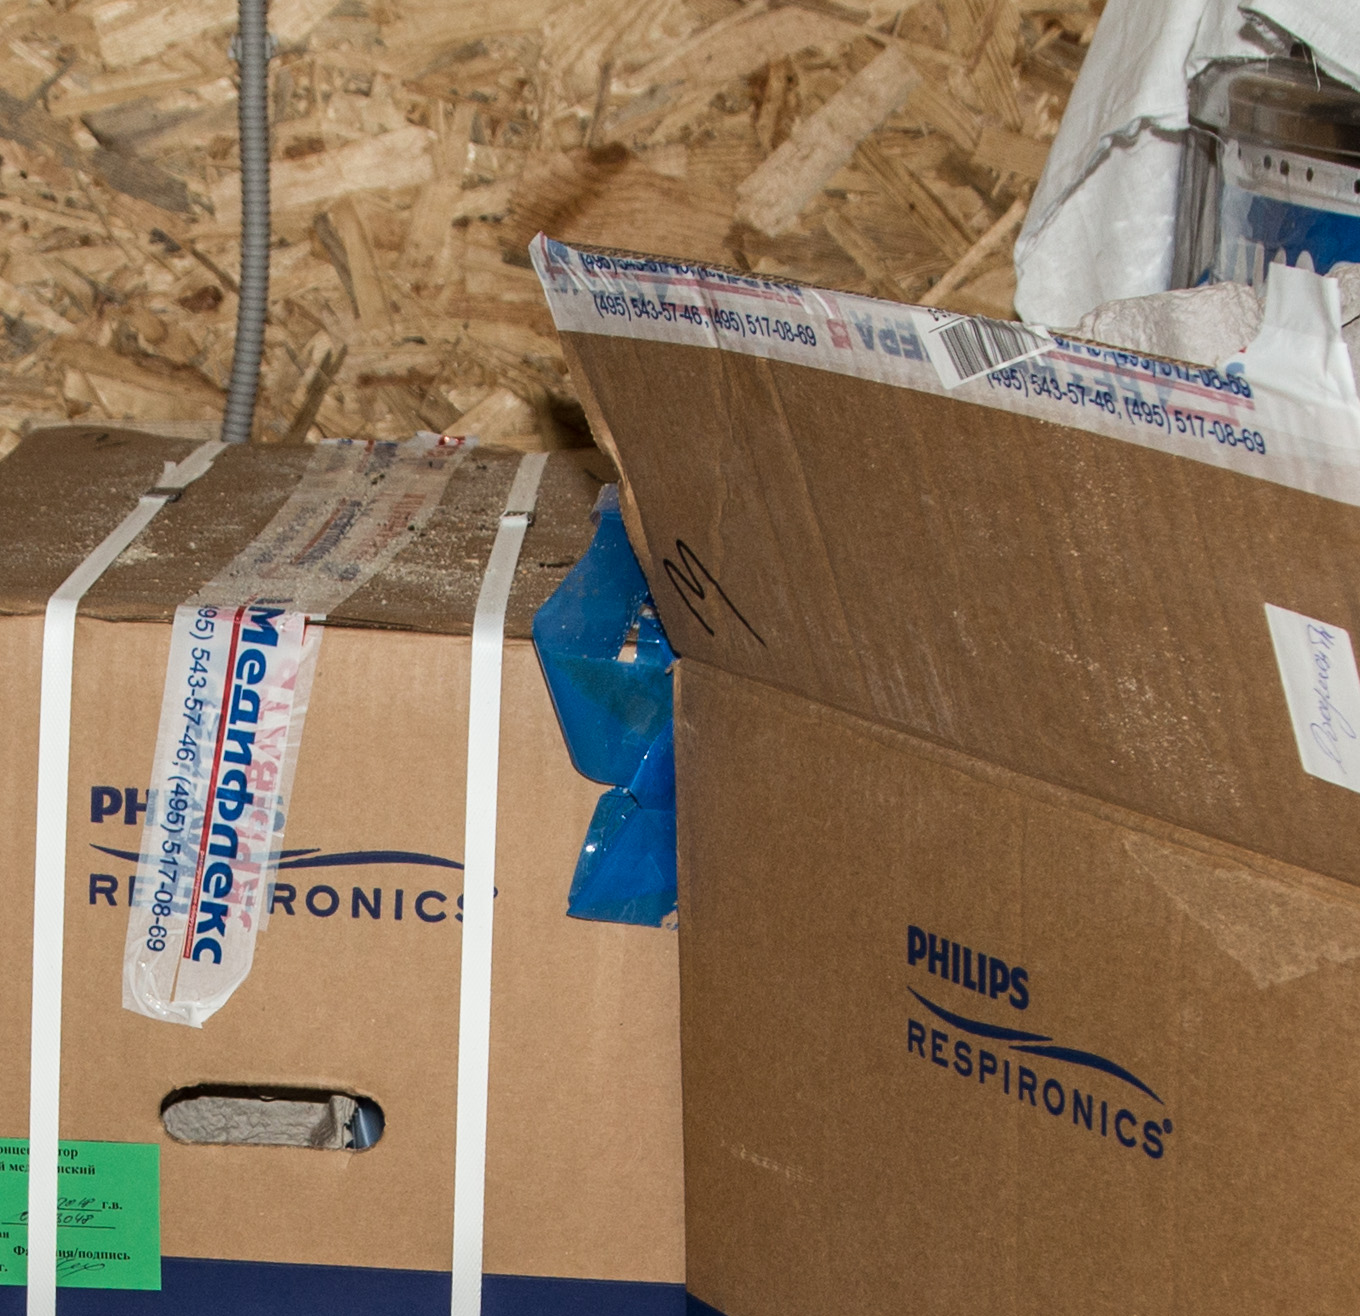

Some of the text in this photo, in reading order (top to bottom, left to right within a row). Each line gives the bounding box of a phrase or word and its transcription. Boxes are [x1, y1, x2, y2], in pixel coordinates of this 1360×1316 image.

[593, 294, 631, 321] (495)
[707, 308, 745, 337] (495)
[748, 314, 817, 347] 517-08-69
[986, 367, 1029, 398] (495)
[1124, 396, 1172, 435] (495)
[1174, 409, 1266, 455] 517-08-69
[188, 603, 220, 642] 95)
[160, 774, 193, 834] (495)
[192, 599, 288, 966] Медифлекс
[145, 838, 182, 953] 517-08-69
[906, 924, 1030, 1010] PHILIPS
[907, 1017, 1167, 1160] RESPIRONICS
